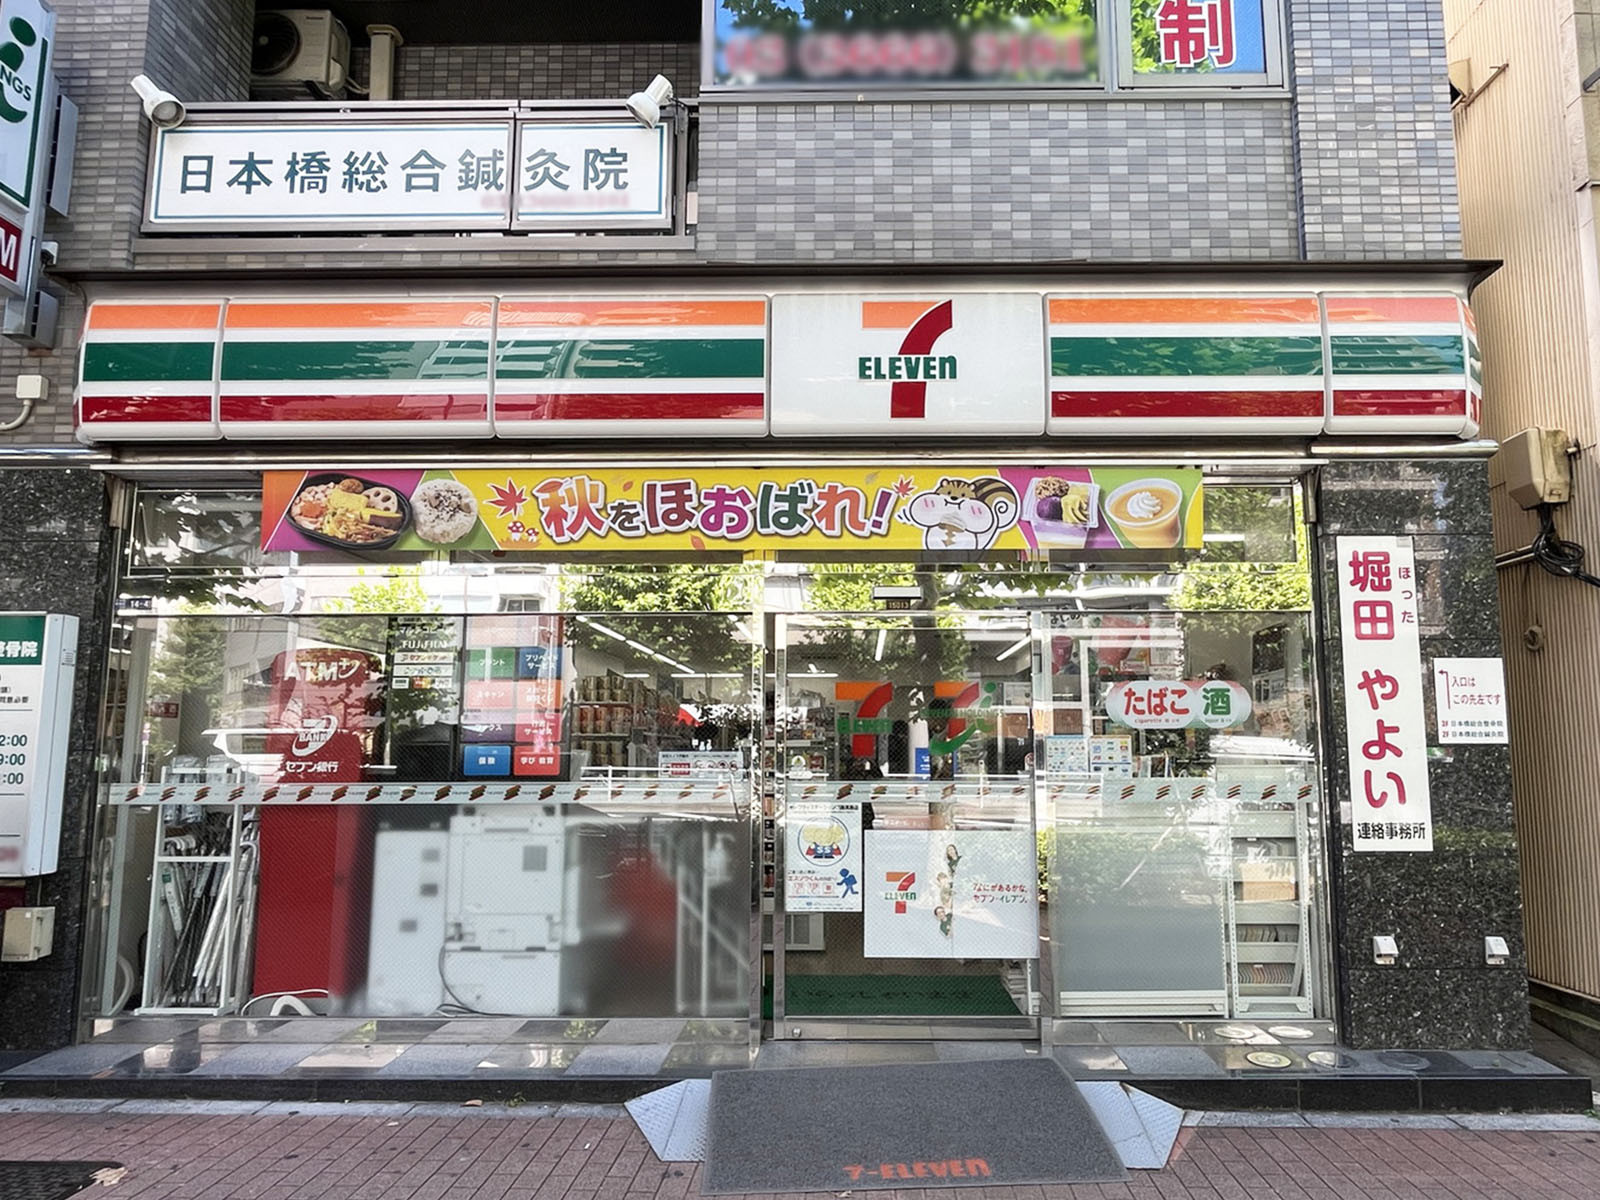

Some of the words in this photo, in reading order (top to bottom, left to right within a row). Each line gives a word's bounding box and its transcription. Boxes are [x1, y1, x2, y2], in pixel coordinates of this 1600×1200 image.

[1157, 0, 1235, 67] 制
[179, 147, 630, 194] 日本橋総合鍼灸院
[1348, 550, 1395, 640] 堀田
[284, 661, 337, 681] ATM
[1124, 688, 1189, 715] たばこ
[1202, 688, 1231, 715] 酒
[1357, 669, 1407, 808] やよい
[286, 761, 339, 773] セブン銀行
[1357, 822, 1426, 840] 連絡事務所
